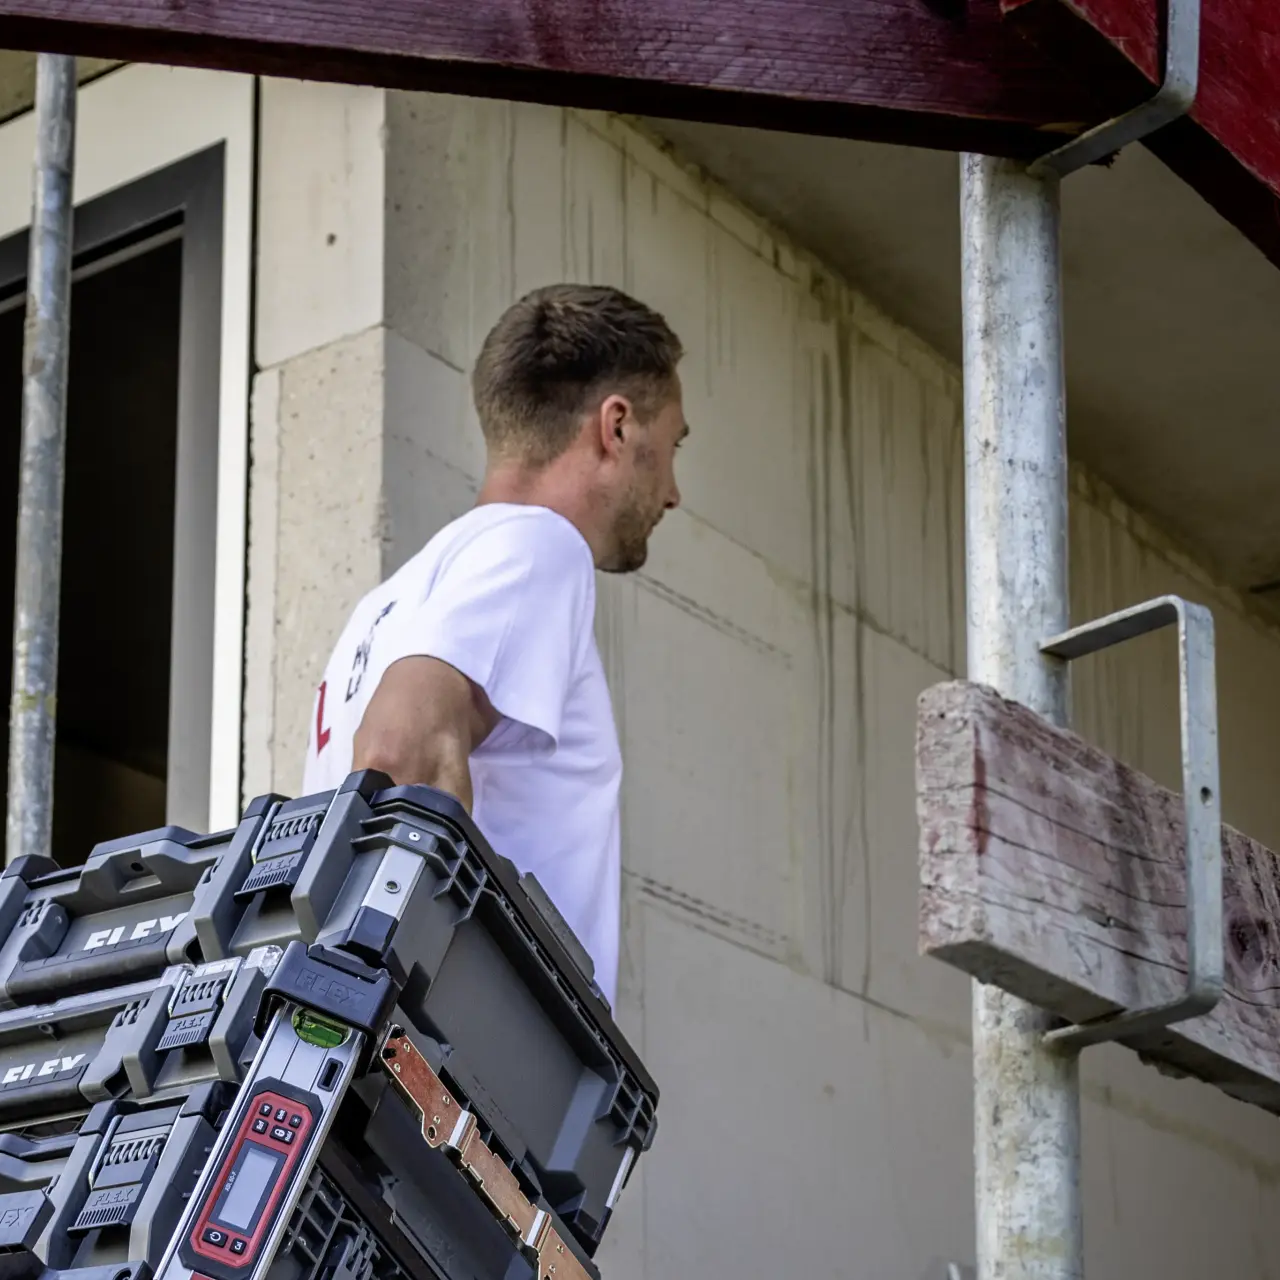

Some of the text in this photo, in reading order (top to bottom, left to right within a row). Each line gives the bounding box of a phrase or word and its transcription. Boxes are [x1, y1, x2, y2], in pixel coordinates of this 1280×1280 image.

[257, 856, 296, 875] FLEX
[294, 967, 366, 1007] FLEX
[172, 1015, 206, 1032] FLEX
[92, 1187, 135, 1207] FLEX
